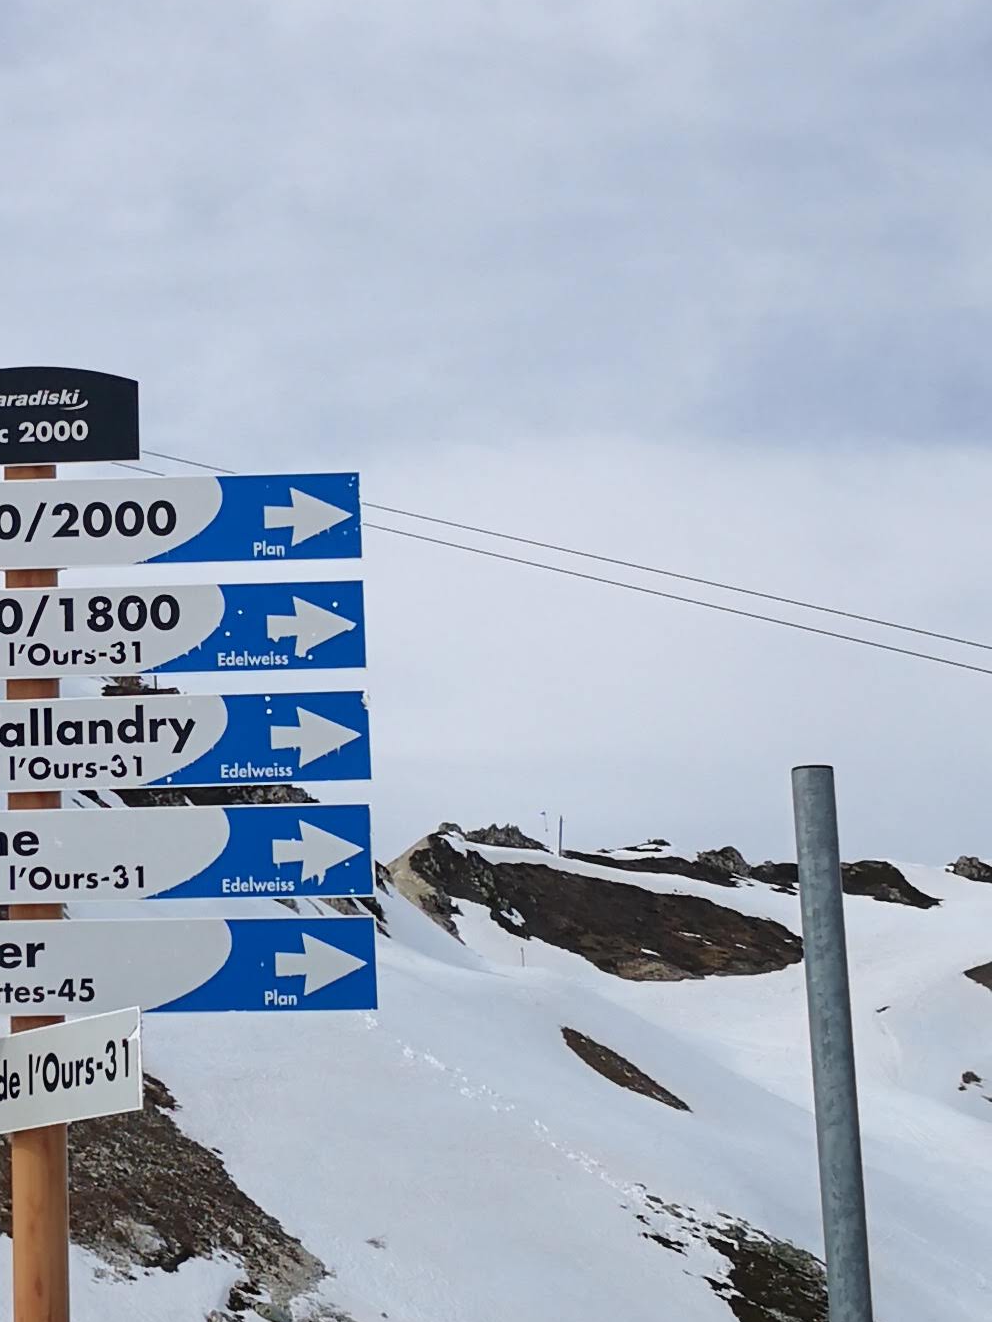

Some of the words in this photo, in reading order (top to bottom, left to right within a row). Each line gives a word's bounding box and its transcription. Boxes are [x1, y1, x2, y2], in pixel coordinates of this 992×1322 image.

[18, 419, 89, 444] 2000
[253, 540, 286, 558] Plan
[216, 650, 290, 667] Edelweiss
[220, 761, 294, 779] Edelweiss
[221, 876, 296, 893] Edelweiss
[263, 989, 298, 1007] Plan
